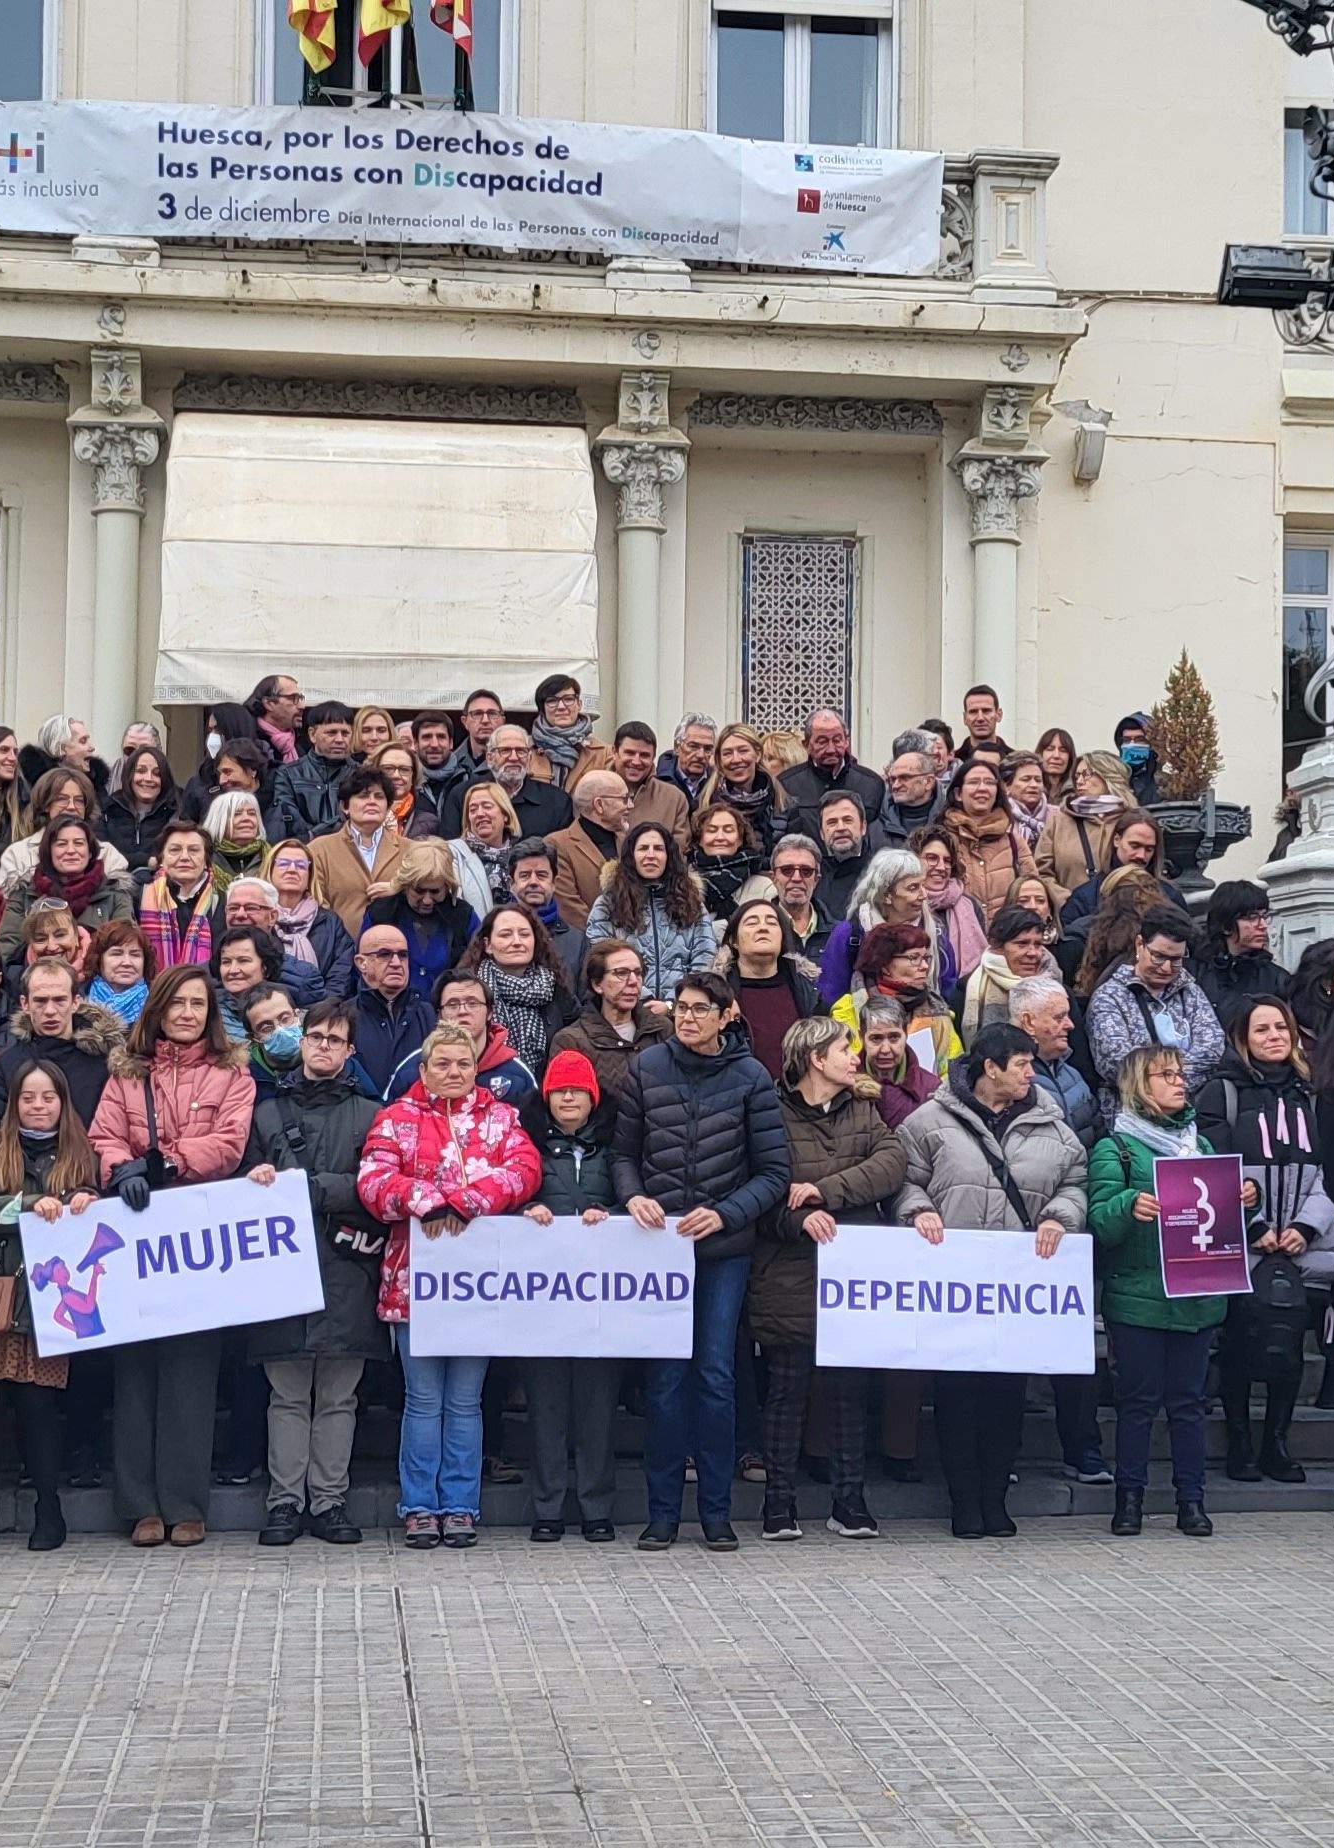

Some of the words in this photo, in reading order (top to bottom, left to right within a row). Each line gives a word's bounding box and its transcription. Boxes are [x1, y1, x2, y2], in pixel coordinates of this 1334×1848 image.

[157, 121, 273, 151] Huesca,
[284, 131, 334, 154] por
[344, 125, 384, 149] los
[395, 128, 525, 157] Derechos
[535, 135, 570, 160] de
[23, 179, 99, 198] inclusiva
[158, 153, 199, 179] las
[210, 156, 344, 183] Personas
[354, 167, 403, 185] con
[414, 162, 603, 197] Discapacidad
[823, 201, 834, 210] de
[835, 201, 867, 212] Huesca
[824, 189, 882, 204] Ayuntamiento
[157, 192, 178, 220] 3
[184, 195, 213, 222] de
[218, 195, 331, 224] diciembre
[338, 211, 363, 225] Día
[368, 212, 465, 228] Internacional
[470, 215, 488, 230] de
[493, 217, 514, 232] las
[519, 219, 587, 236] Personas
[591, 226, 617, 238] con
[621, 226, 720, 246] Discapacidad
[135, 1215, 302, 1280] MUJER
[413, 1270, 690, 1303] DISCAPACIDAD
[819, 1278, 1087, 1316] DEPENDENCIA
